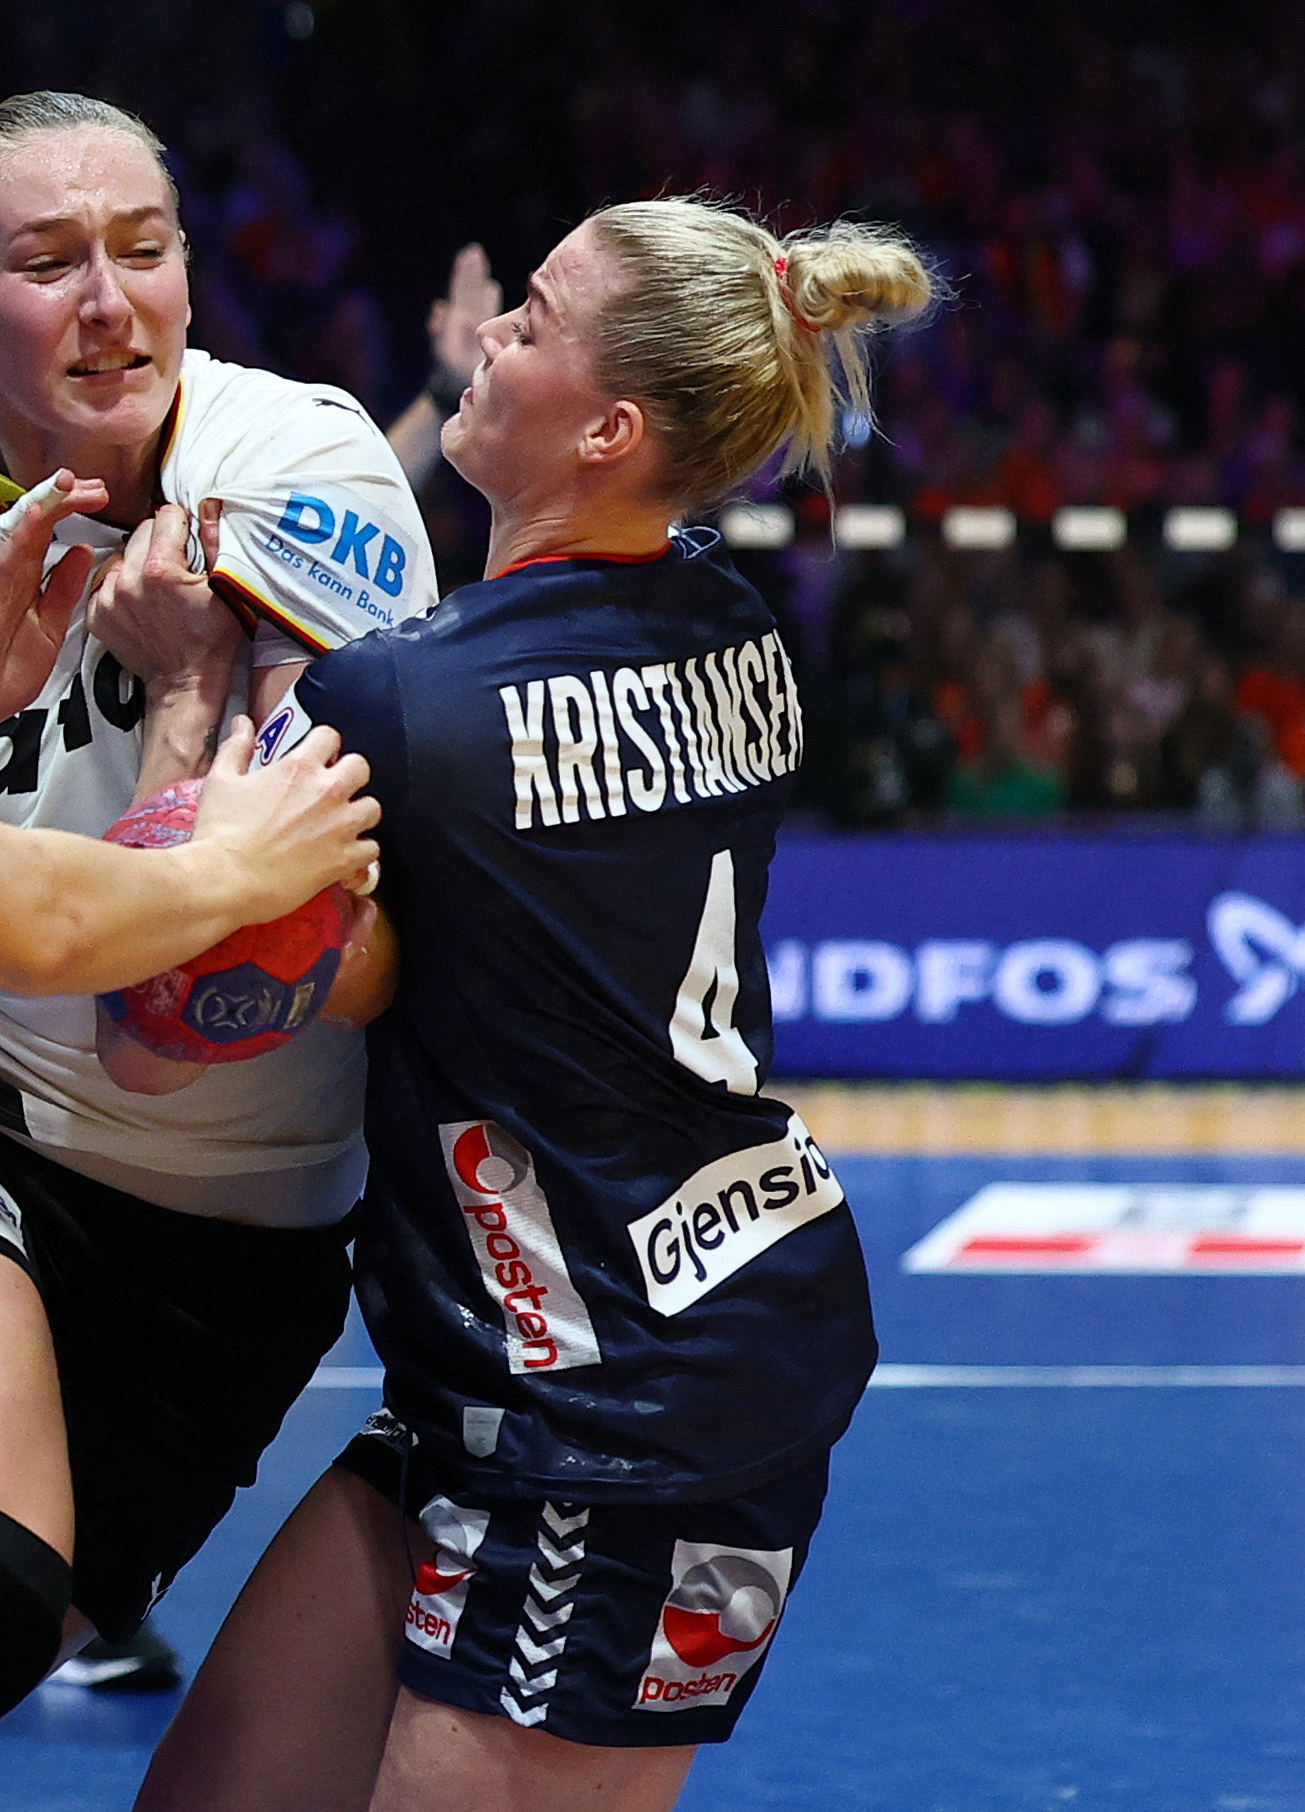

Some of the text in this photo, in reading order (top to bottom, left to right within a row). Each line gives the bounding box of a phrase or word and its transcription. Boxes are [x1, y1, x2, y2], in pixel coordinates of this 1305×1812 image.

[264, 534, 394, 629] Das kann Bank
[277, 491, 406, 598] DKB
[669, 848, 759, 1097] 4
[463, 1203, 558, 1369] posten
[639, 1671, 737, 1705] posten
